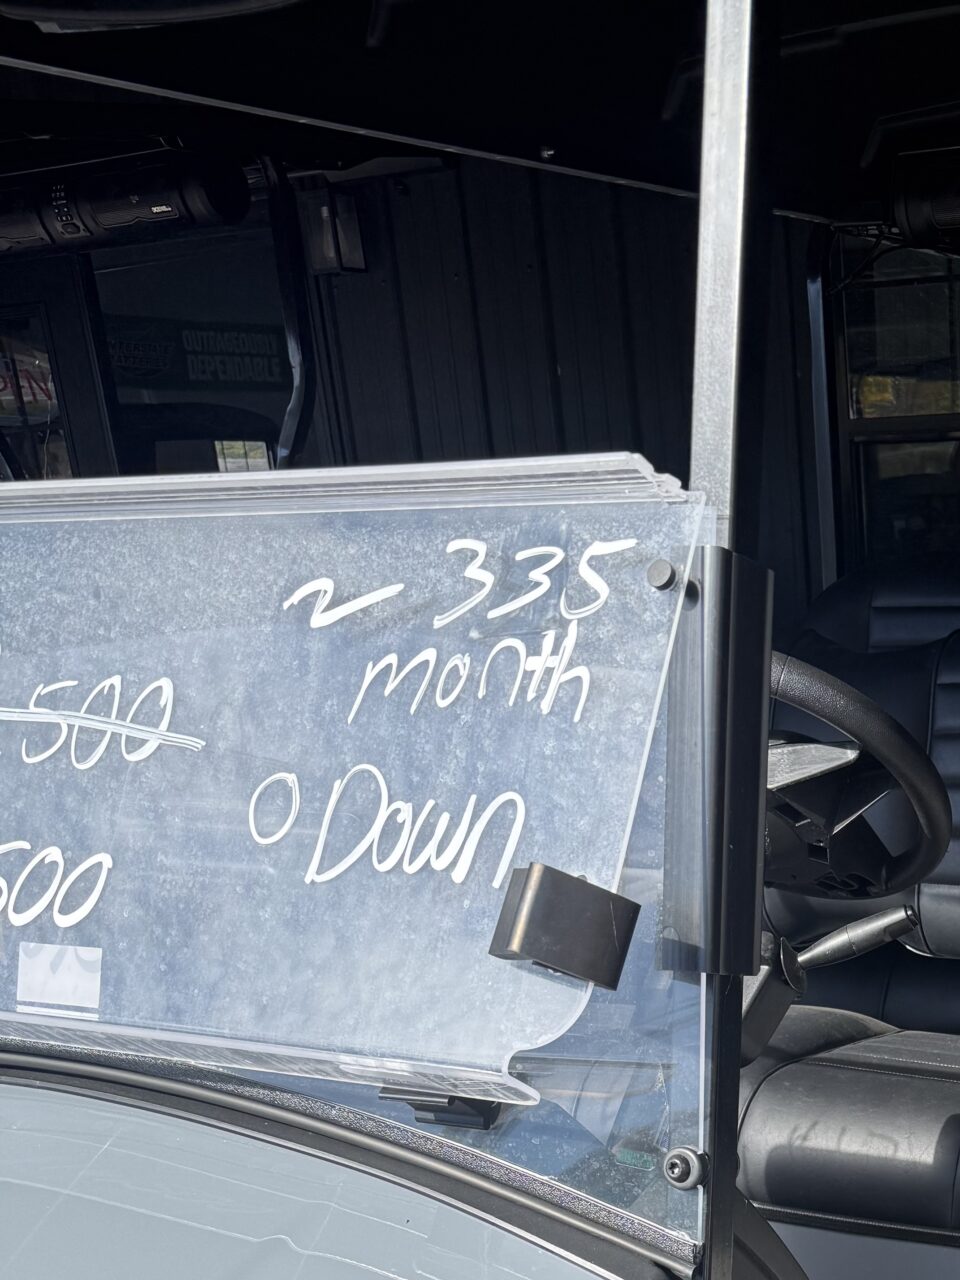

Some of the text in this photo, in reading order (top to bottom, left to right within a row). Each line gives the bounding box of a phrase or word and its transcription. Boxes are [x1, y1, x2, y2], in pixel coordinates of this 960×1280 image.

[182, 329, 279, 356] OUTRAGEOUSLY
[186, 354, 282, 382] DEPENDABLE
[433, 538, 637, 630] 335
[347, 619, 592, 724] month
[305, 763, 526, 888] Down
